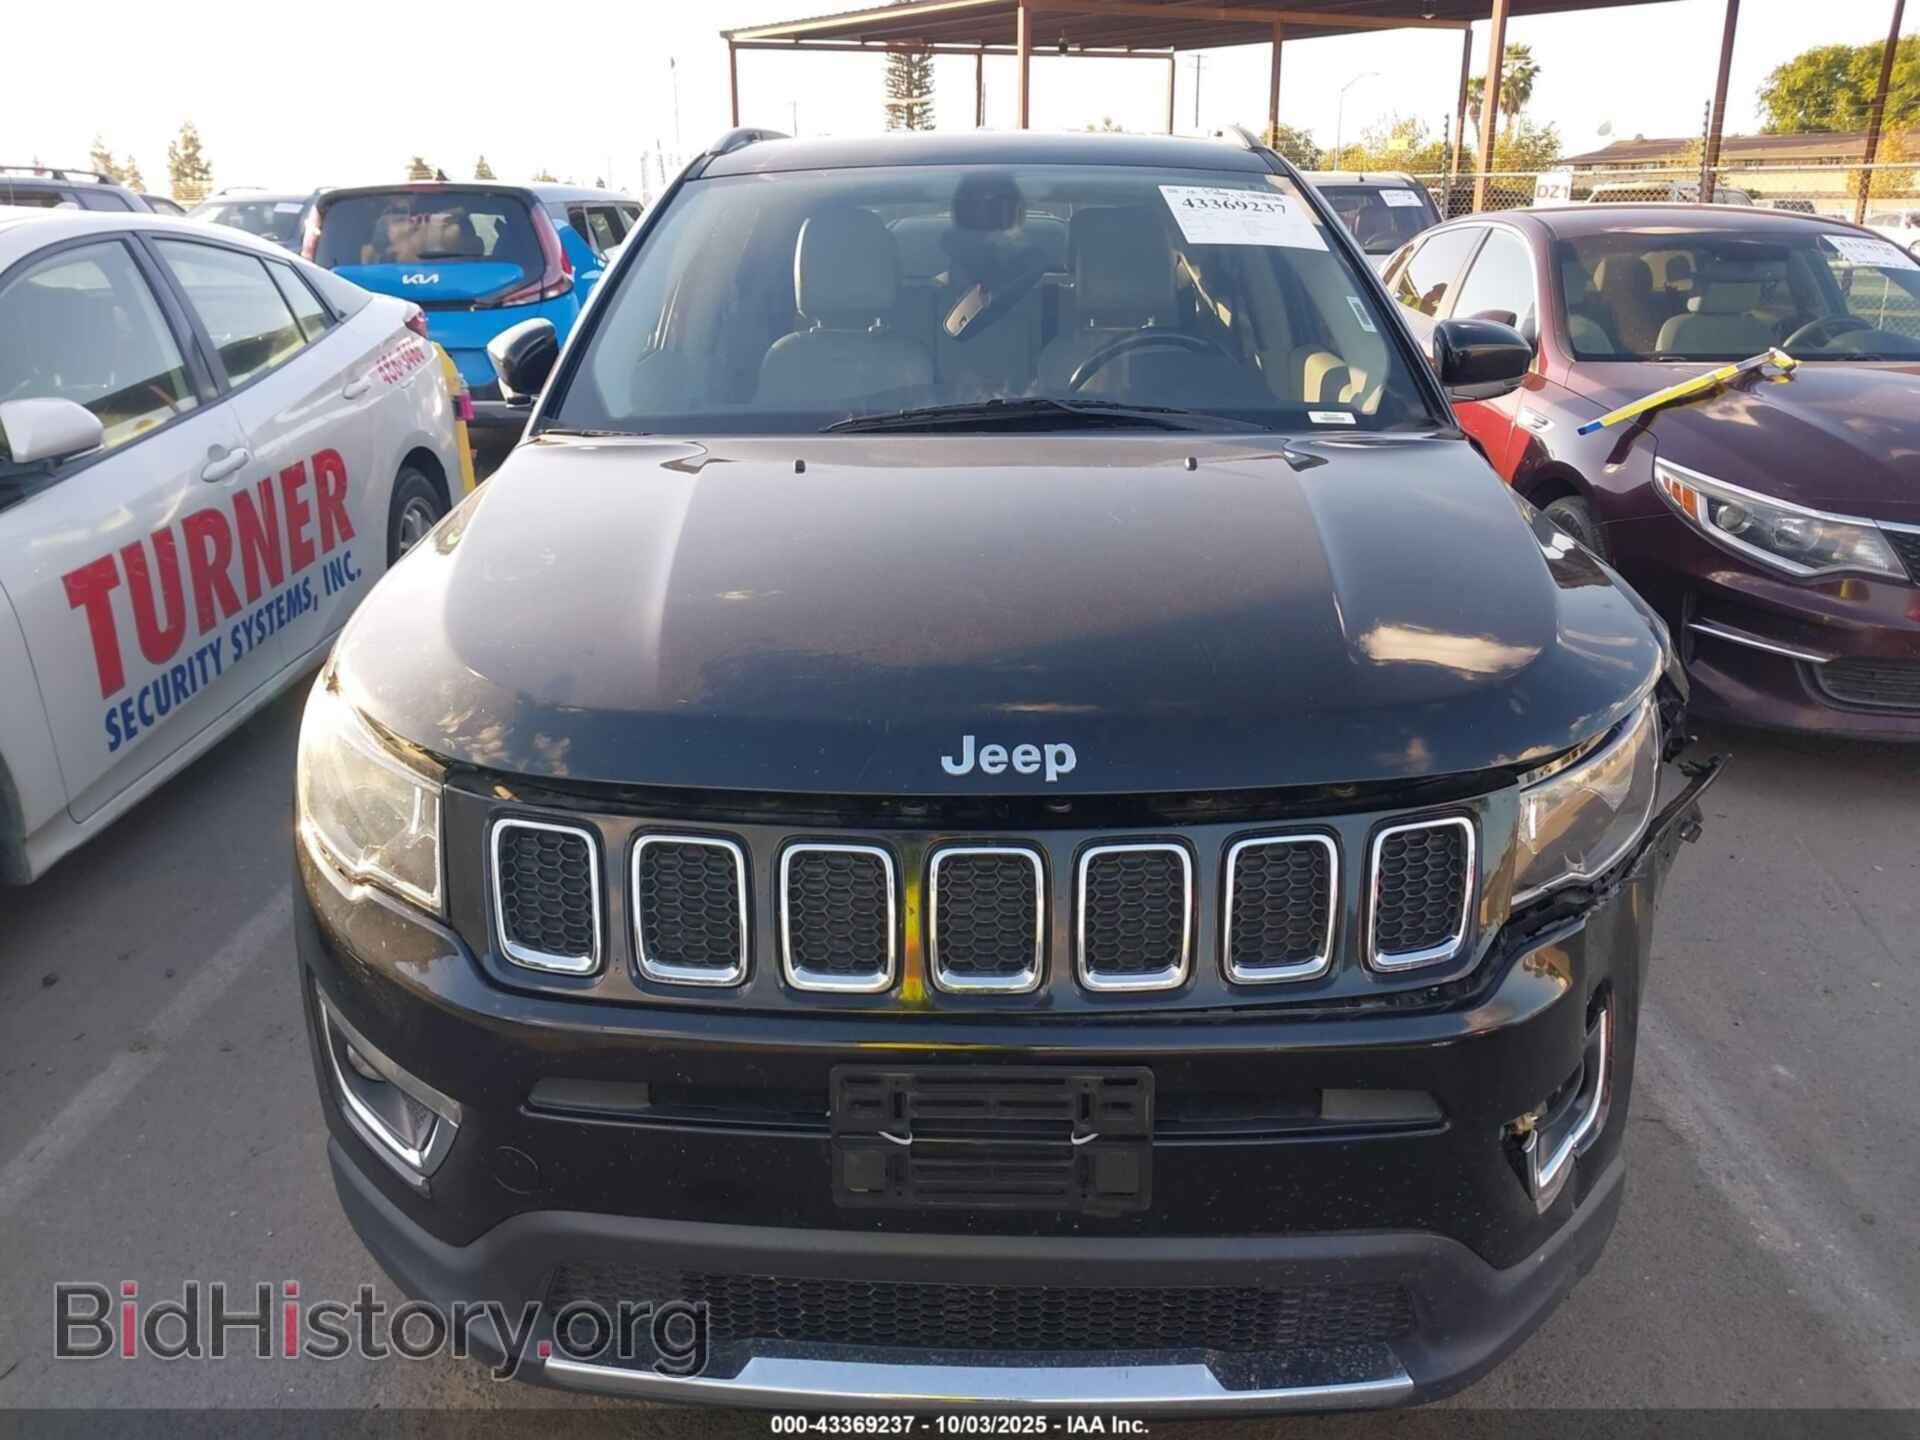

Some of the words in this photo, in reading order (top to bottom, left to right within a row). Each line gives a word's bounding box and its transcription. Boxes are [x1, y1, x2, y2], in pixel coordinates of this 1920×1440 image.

[1182, 197, 1287, 215] 43369237
[61, 448, 355, 700] TURNER
[105, 637, 222, 752] SECURITY
[231, 576, 319, 663] SYSTEMS,
[322, 550, 362, 596] INC.
[941, 734, 1077, 782] Jeep
